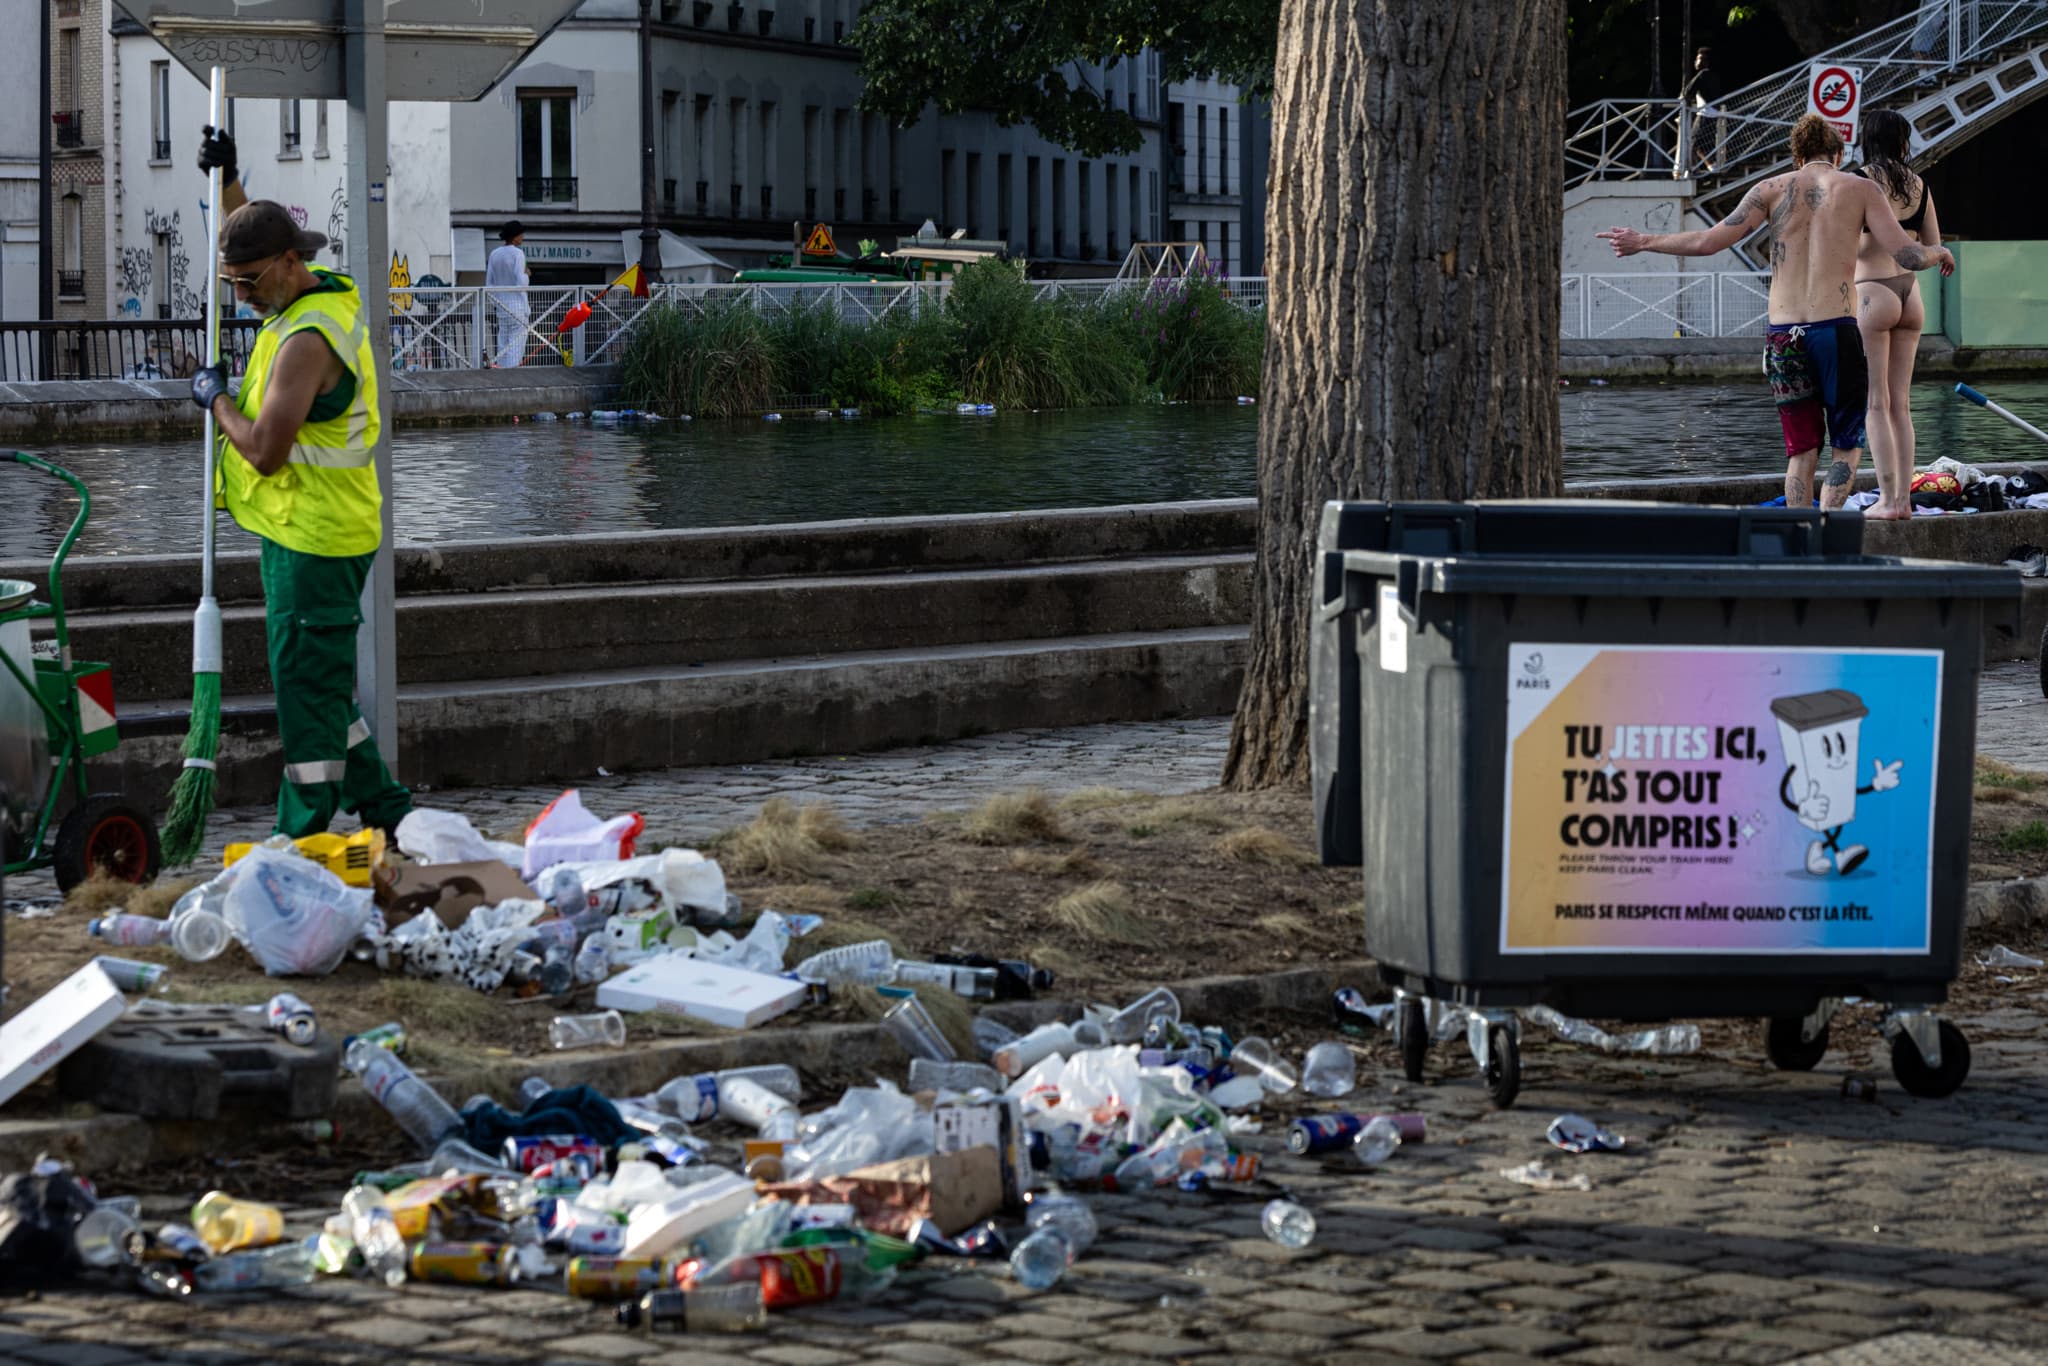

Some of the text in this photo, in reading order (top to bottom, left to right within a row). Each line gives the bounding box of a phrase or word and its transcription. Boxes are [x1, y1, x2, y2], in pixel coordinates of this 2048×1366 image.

[548, 247, 582, 258] MANGO
[1516, 678, 1551, 690] PARIS
[1564, 724, 1767, 765] TU JETTES ICI,
[1562, 770, 1722, 804] T'AS TOUT
[1560, 813, 1722, 849] COMPRIS
[1559, 854, 1596, 863] PLEASE
[1599, 854, 1637, 863] THROW
[1639, 855, 1668, 864] YOUR
[1670, 855, 1703, 864] TRASH
[1558, 865, 1585, 874] KEEP
[1586, 865, 1616, 874] PARIS
[1554, 901, 1873, 921] PARIS SE RESPECTE MÊME QUAND C'EST LA FÊTE.
